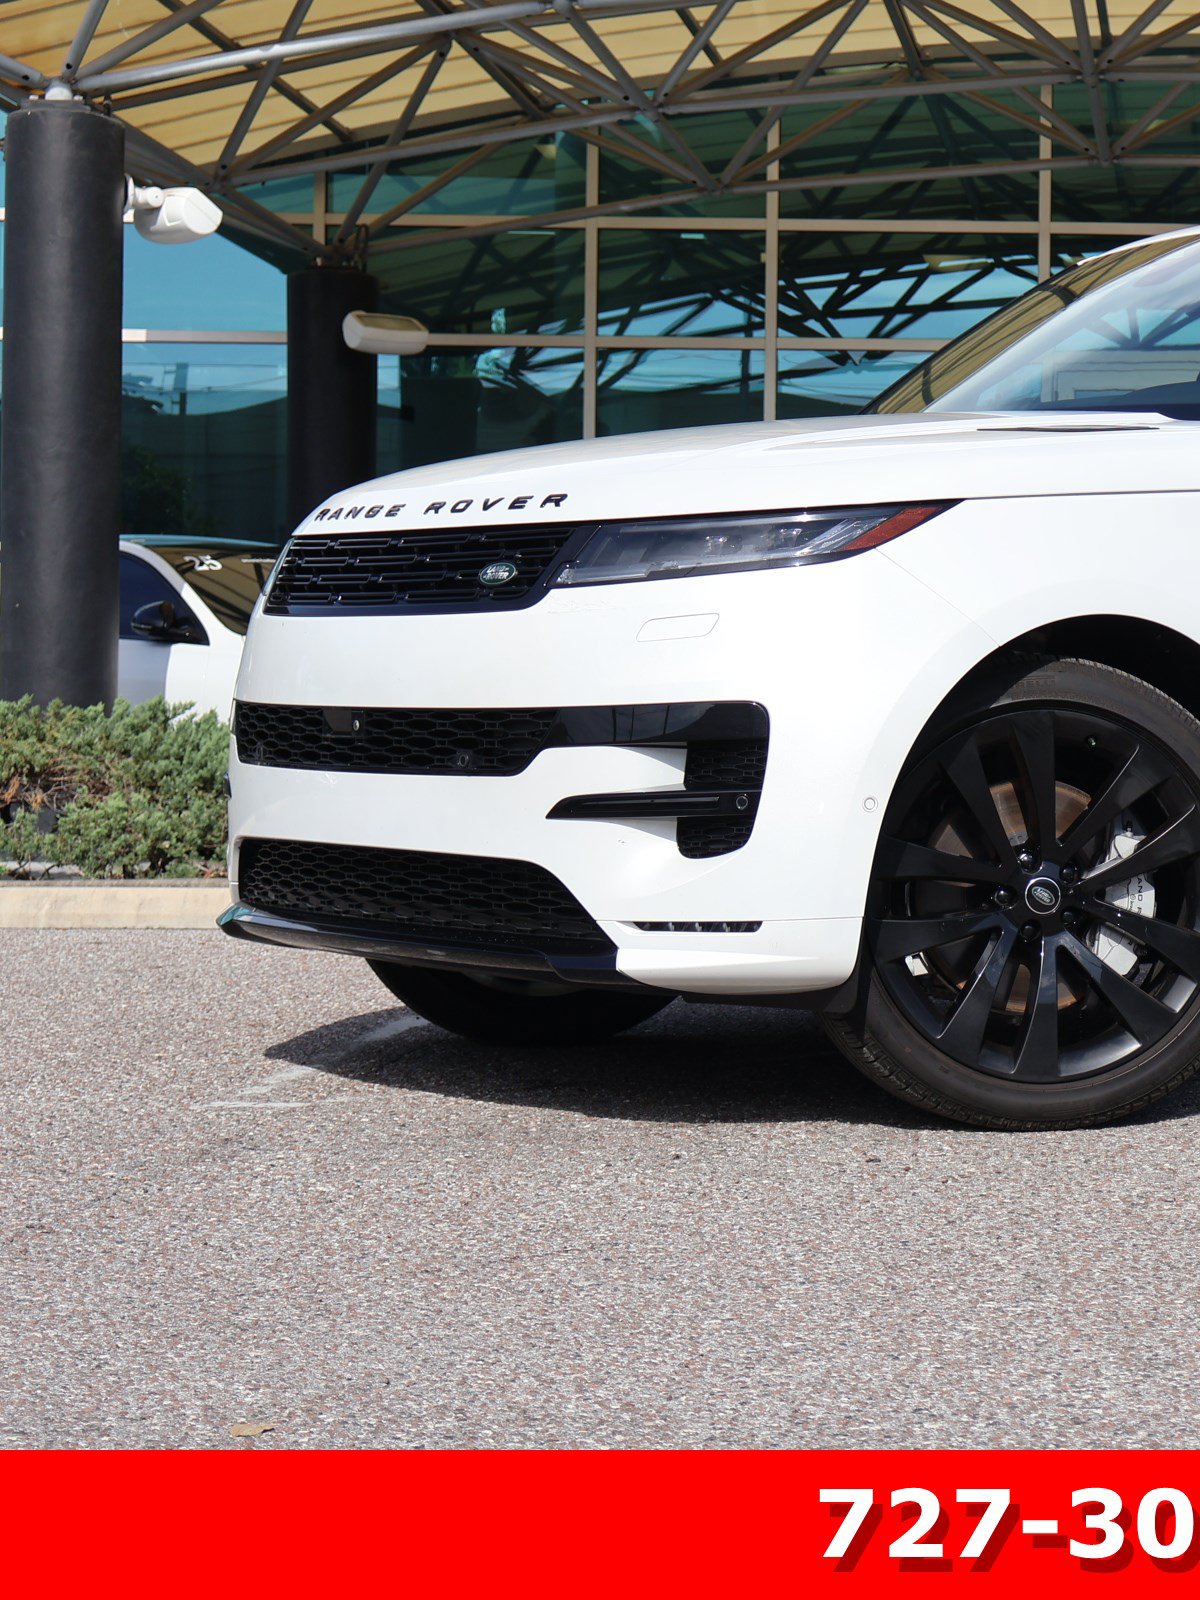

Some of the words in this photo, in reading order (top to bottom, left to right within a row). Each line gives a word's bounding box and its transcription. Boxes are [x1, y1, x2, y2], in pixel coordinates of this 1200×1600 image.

[313, 503, 407, 522] RANGE
[423, 493, 569, 516] ROVER
[183, 554, 223, 572] 25
